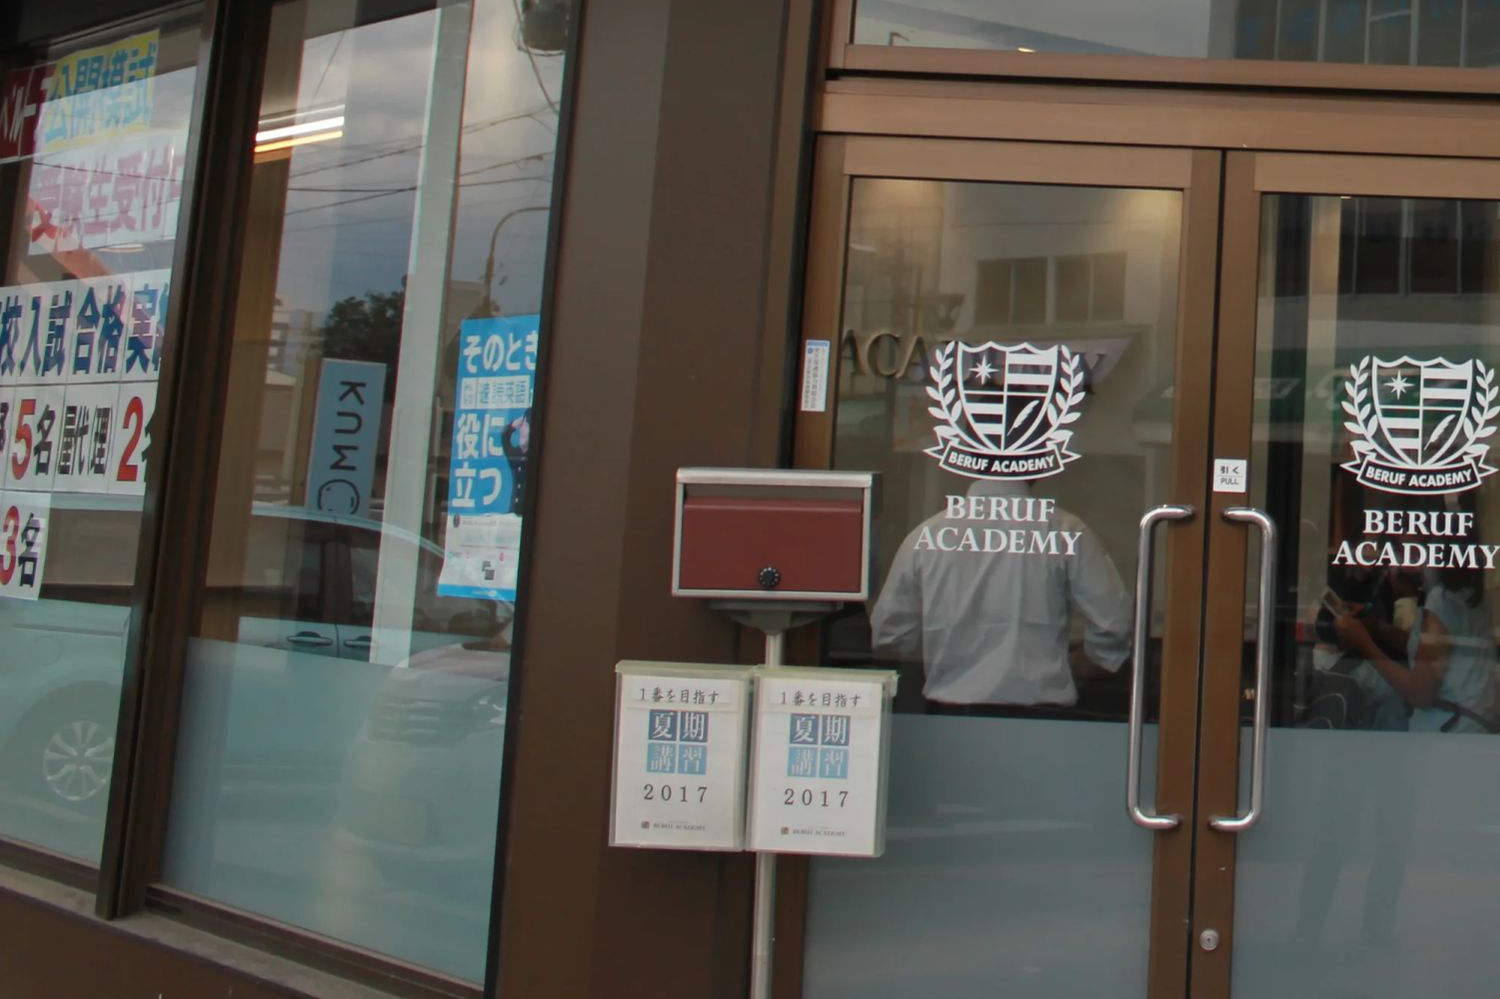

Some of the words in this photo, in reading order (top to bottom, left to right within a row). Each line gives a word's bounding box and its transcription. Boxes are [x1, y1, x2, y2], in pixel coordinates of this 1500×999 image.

[462, 329, 538, 374] そのとき
[456, 413, 505, 460] 役に
[948, 450, 989, 471] BERUF
[991, 454, 1055, 473] ACADEMY
[451, 462, 503, 509] 立つ
[1364, 466, 1406, 486] BERUF
[1408, 468, 1474, 488] ACADEMY
[945, 494, 1056, 522] BERUF
[1363, 509, 1475, 537] BERUF
[913, 526, 1083, 556] ACADEMY
[651, 711, 706, 741] 夏期
[793, 714, 847, 745] 夏期
[643, 783, 708, 803] 2017
[784, 788, 849, 808] 2017
